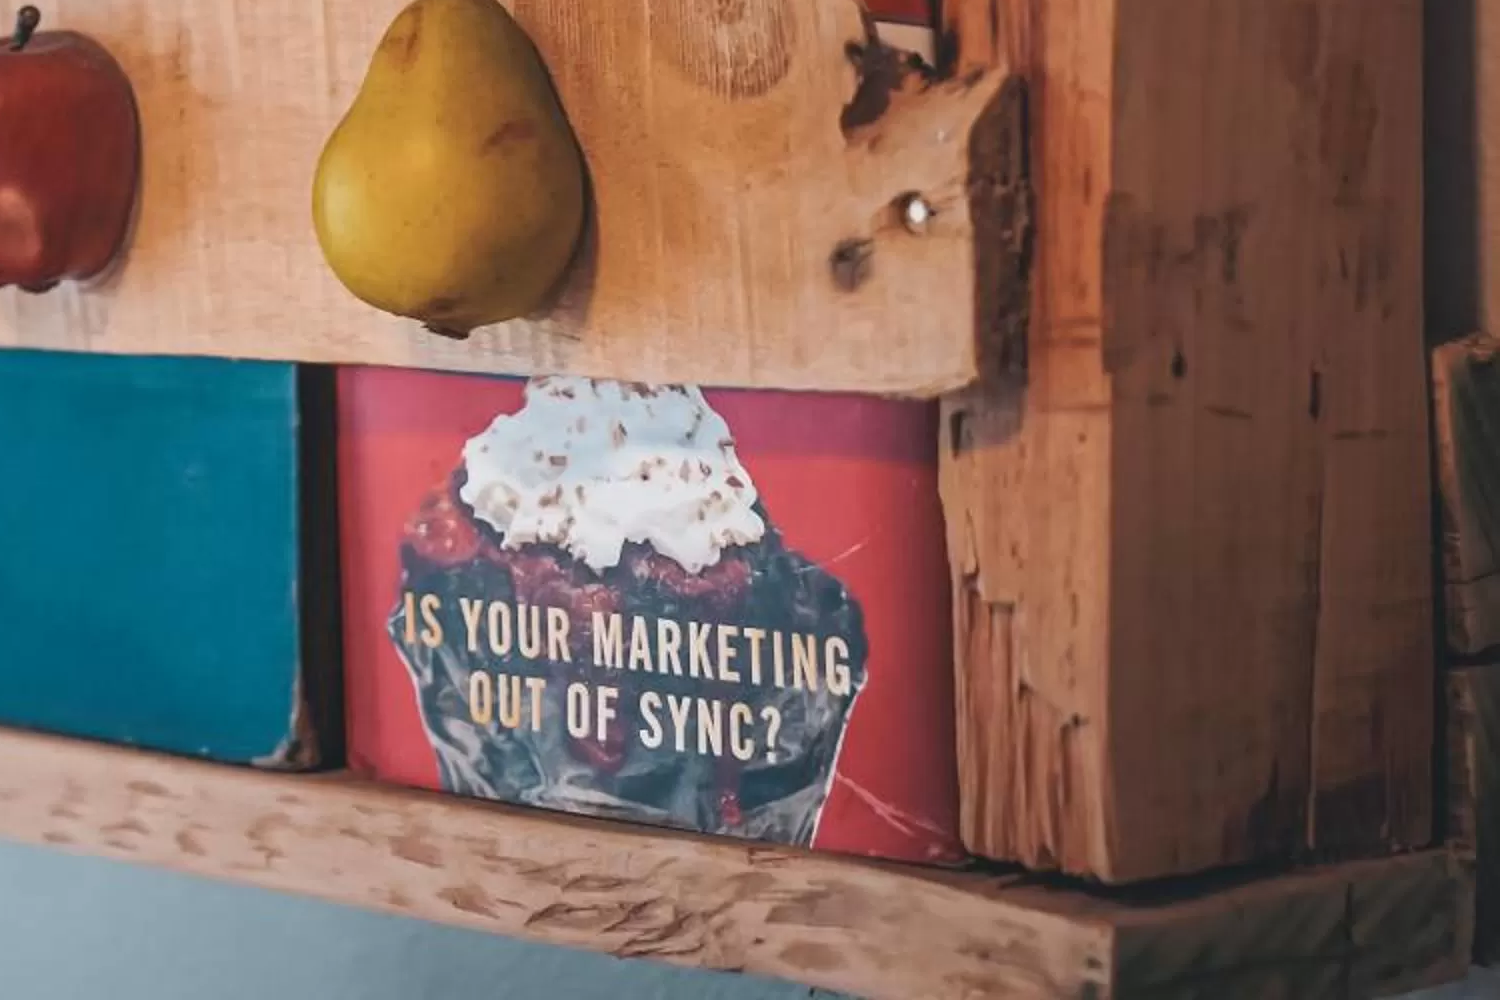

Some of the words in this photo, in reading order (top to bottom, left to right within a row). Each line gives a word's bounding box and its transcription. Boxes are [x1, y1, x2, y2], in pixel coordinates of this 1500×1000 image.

[404, 592, 443, 648] IS
[459, 597, 571, 664] YOUR
[592, 611, 851, 696] MARKETING
[468, 670, 546, 733] OUT
[567, 682, 619, 741] OF
[639, 690, 782, 763] SYNC?
